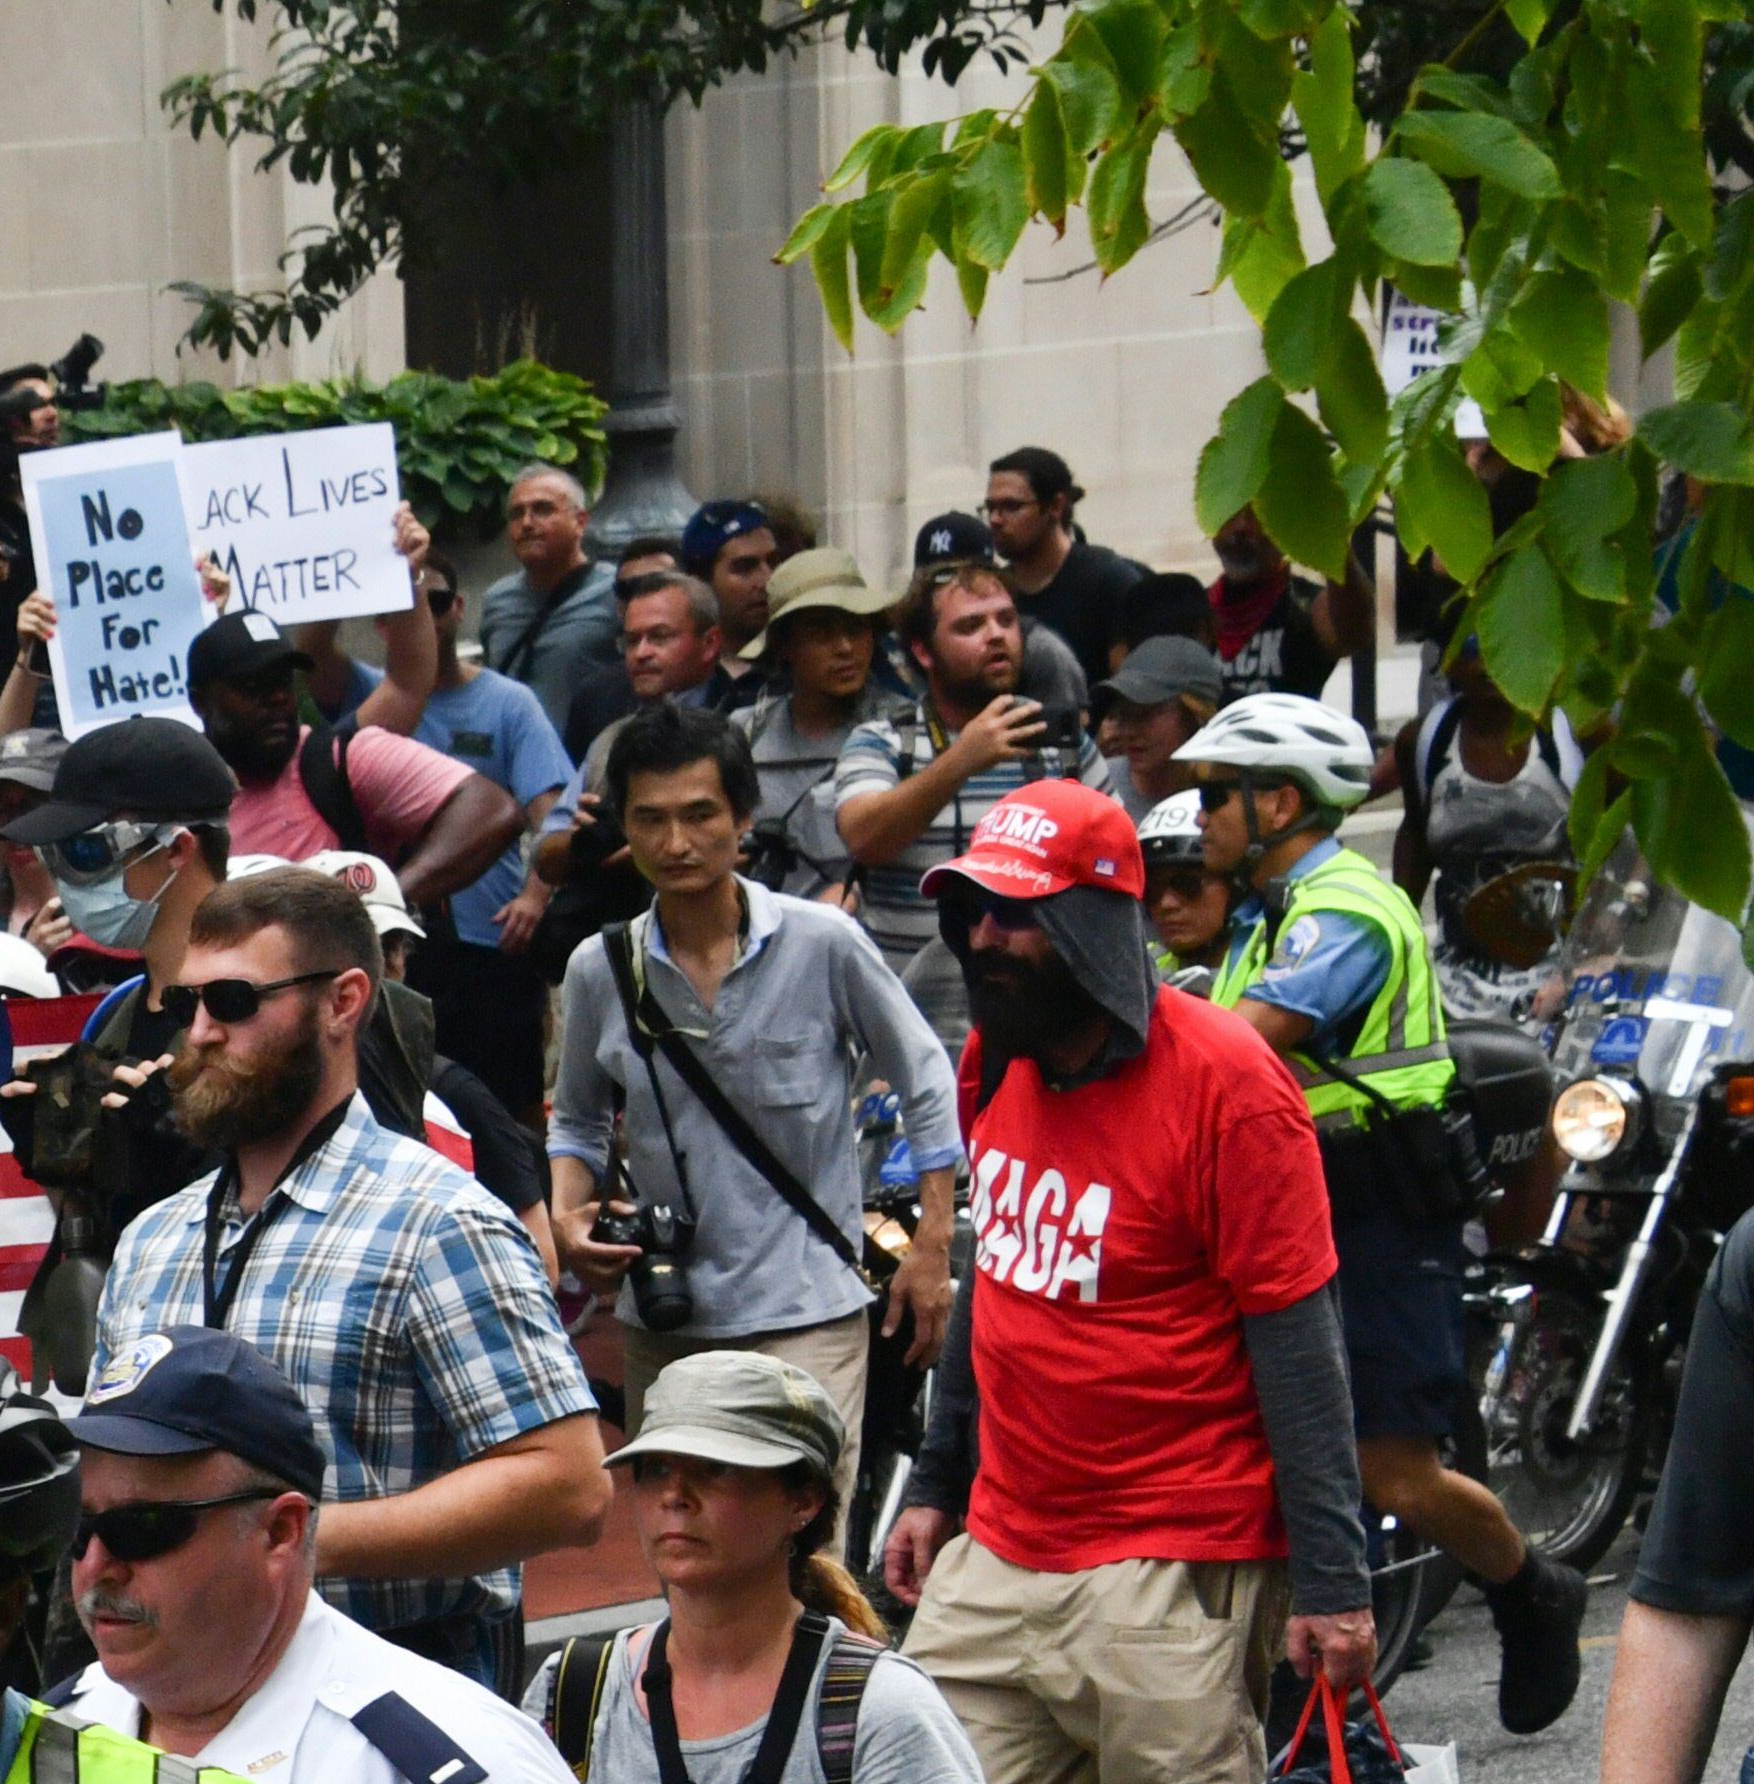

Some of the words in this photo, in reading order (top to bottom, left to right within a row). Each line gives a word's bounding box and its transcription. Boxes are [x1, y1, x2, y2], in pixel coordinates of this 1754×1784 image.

[197, 482, 270, 531] ACK
[282, 447, 389, 519] LIVES
[80, 489, 144, 547] No
[66, 561, 166, 609] Place
[209, 543, 361, 611] MATTER
[101, 612, 160, 651] For
[88, 654, 186, 710] Hate!
[1139, 806, 1188, 834] 19
[1487, 1122, 1543, 1164] POLIC
